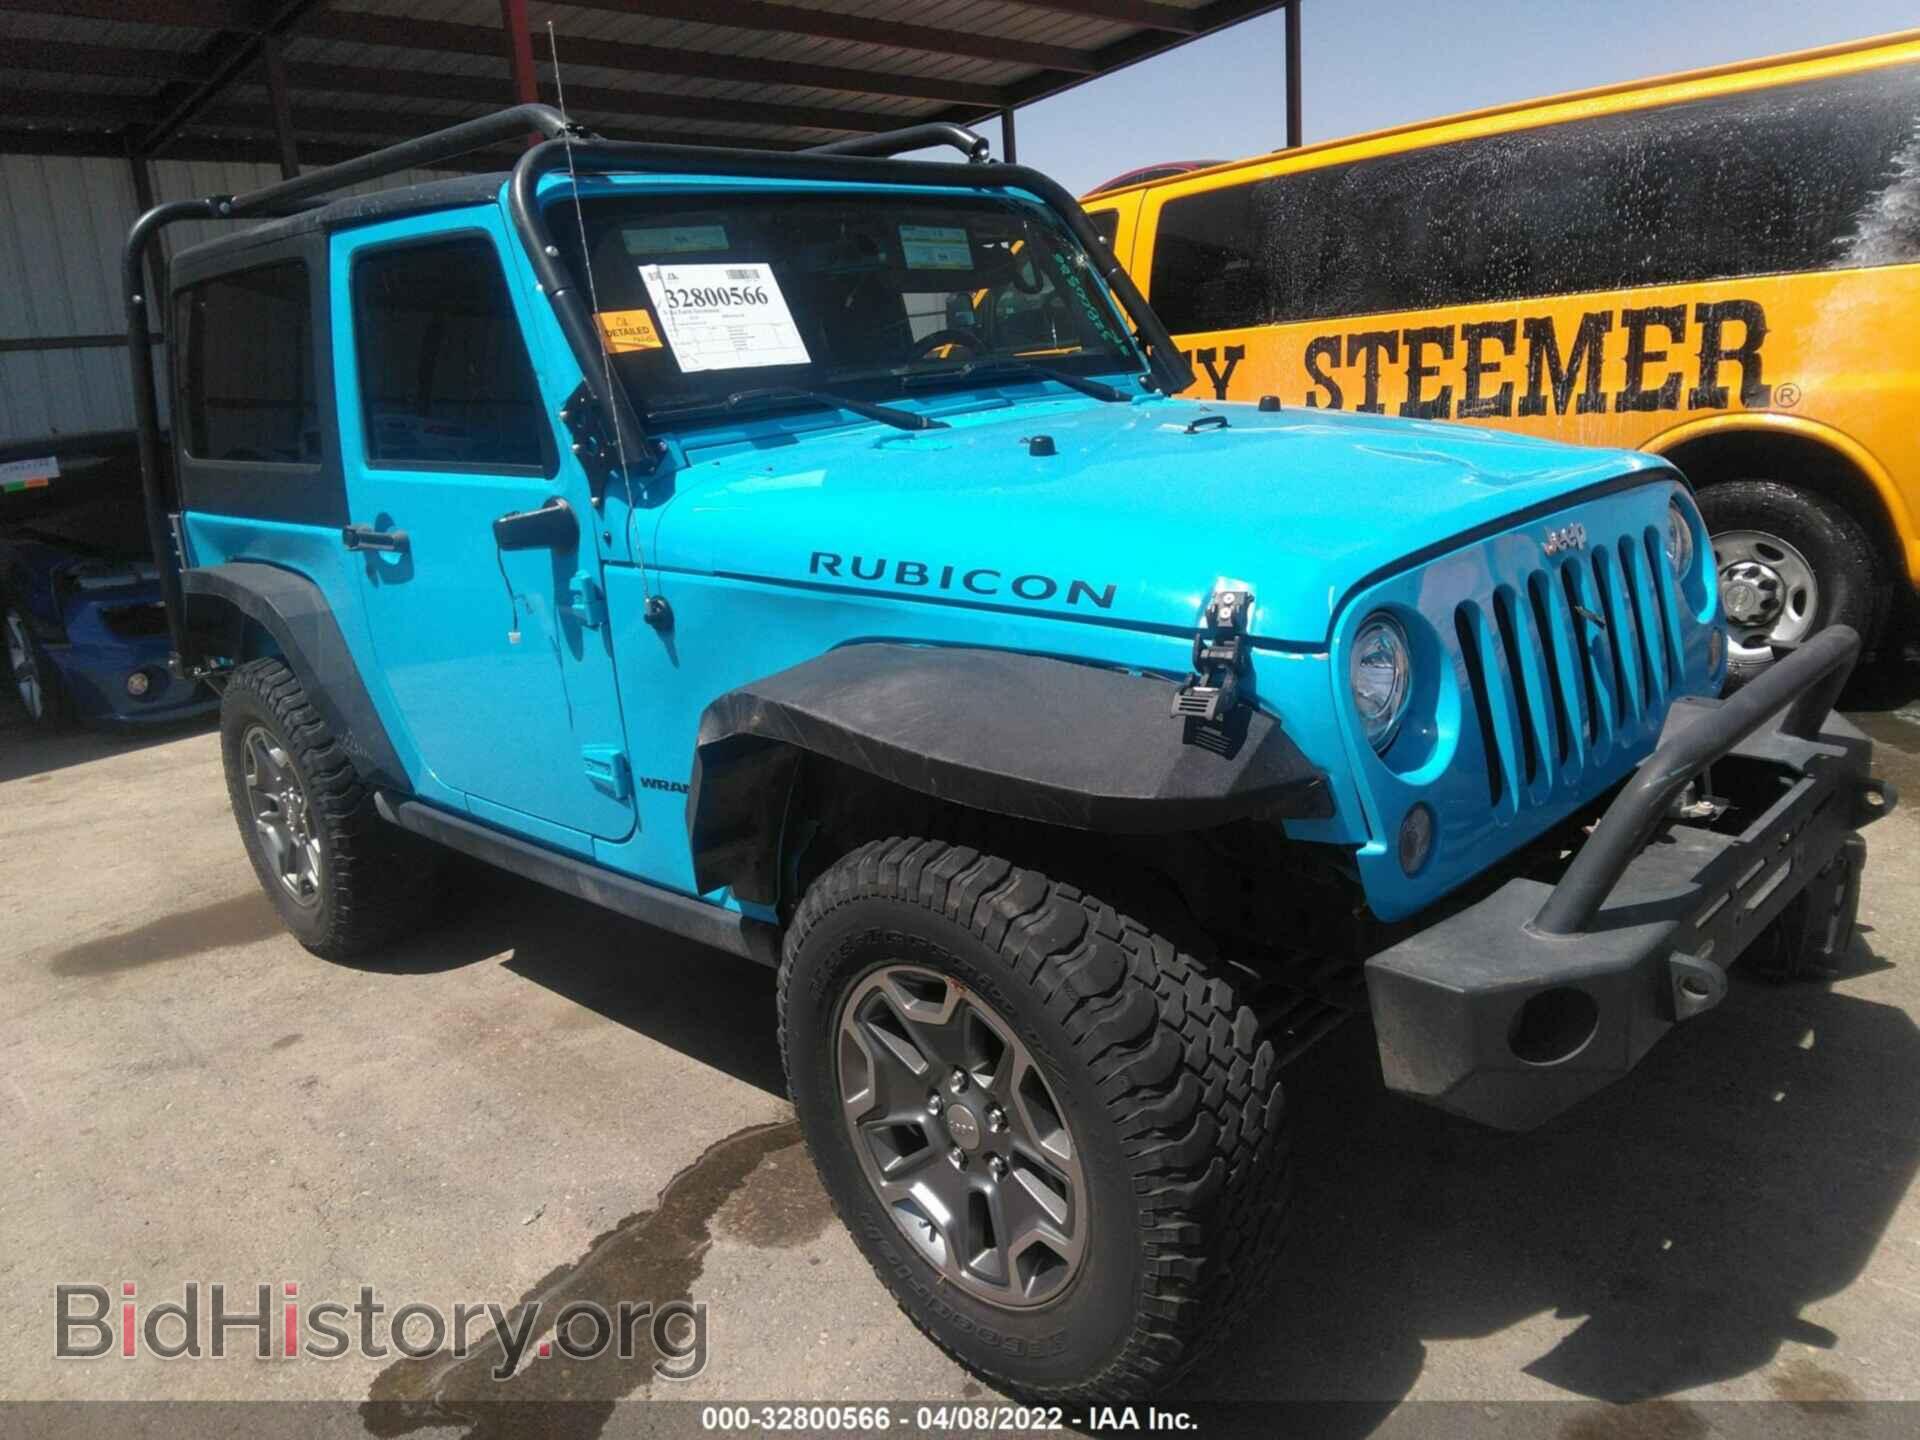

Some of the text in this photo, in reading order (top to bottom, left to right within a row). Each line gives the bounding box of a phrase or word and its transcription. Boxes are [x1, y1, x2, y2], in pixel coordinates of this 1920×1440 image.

[665, 286, 768, 309] 32800566
[604, 326, 650, 337] DETAILED
[1305, 299, 1773, 419] STEEMER
[1541, 522, 1586, 556] Jeep
[809, 551, 1117, 609] RUBICON
